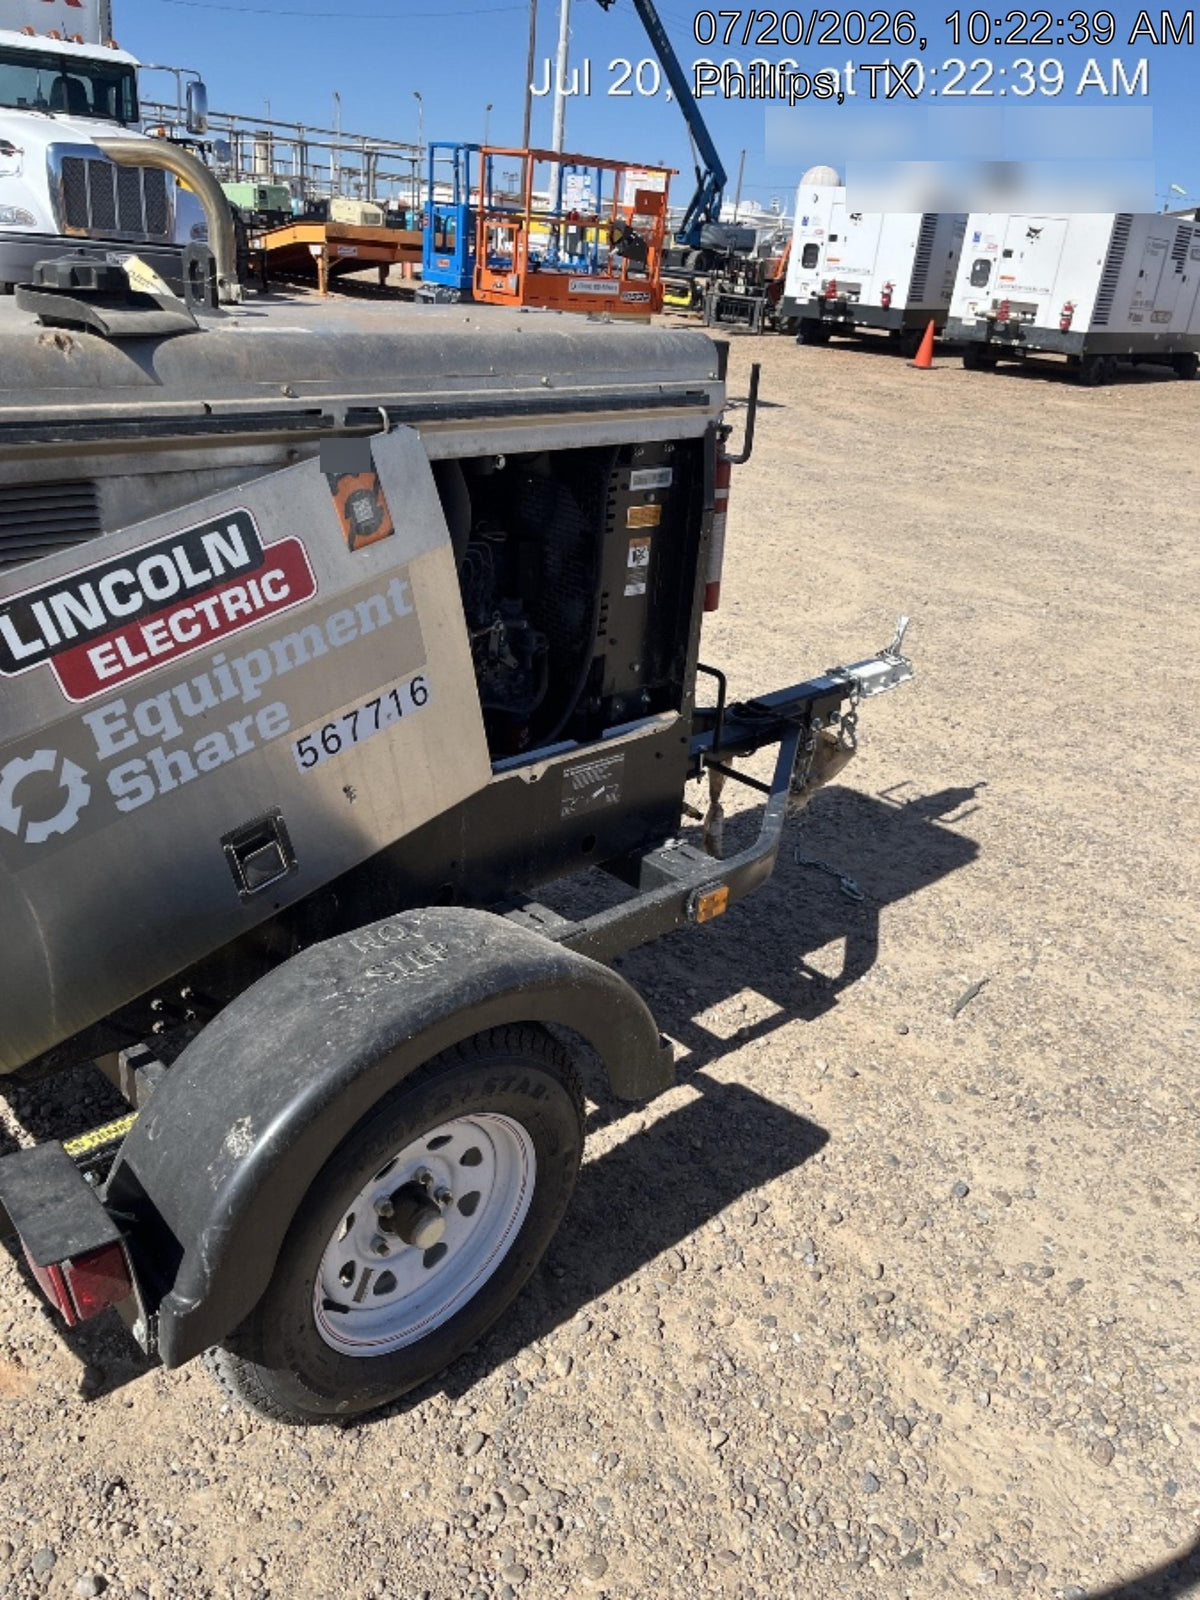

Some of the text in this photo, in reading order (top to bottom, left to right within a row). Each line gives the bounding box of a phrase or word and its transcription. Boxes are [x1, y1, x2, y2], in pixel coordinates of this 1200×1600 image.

[0, 524, 251, 661] LINCOLN
[87, 568, 292, 681] ELECTRIC
[82, 575, 414, 762] Equipment
[296, 676, 430, 769] 567716
[105, 700, 292, 813] Share
